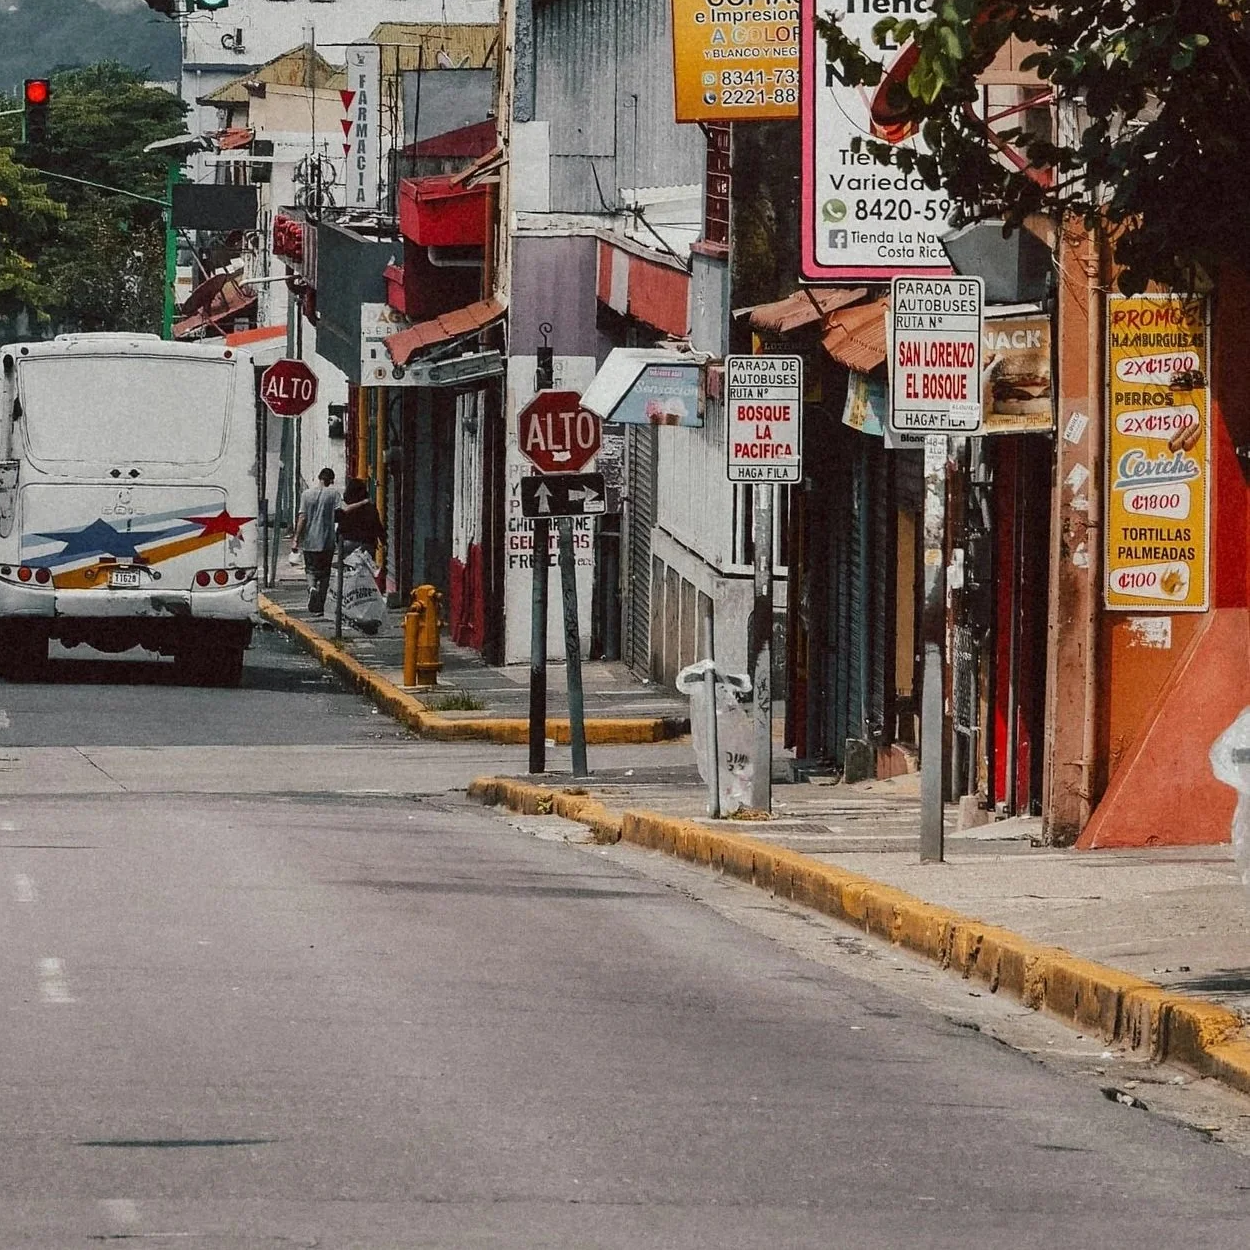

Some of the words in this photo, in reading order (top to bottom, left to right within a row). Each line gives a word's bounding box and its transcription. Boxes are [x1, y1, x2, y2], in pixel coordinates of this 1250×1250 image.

[695, 11, 705, 23] e
[712, 28, 726, 43] A
[713, 47, 760, 58] BLANCO
[764, 47, 769, 57] Y
[355, 74, 368, 203] FARMACIA
[850, 231, 894, 244] Tienda
[898, 231, 913, 244] La
[877, 245, 915, 258] Costa
[919, 246, 948, 258] Rica
[898, 282, 952, 296] PARADA
[958, 283, 976, 296] DE
[898, 299, 977, 312] AUTOBUSES
[896, 315, 924, 328] RUTA
[983, 329, 1041, 350] NACK
[1111, 332, 1204, 348] HAMBURGUESAS
[898, 341, 920, 367] SAN
[924, 341, 975, 368] LORENZO
[731, 360, 776, 371] PARADA
[781, 360, 797, 371] DE
[731, 374, 797, 385] AUTOBUSES
[905, 373, 919, 399] EL
[922, 373, 967, 400] BOSQUE
[266, 375, 312, 401] ALTO
[730, 387, 754, 399] RUTA
[1114, 392, 1175, 406] PERROS
[737, 405, 791, 421] BOSQUE
[905, 413, 935, 426] HAGA
[526, 410, 595, 452] ALTO
[755, 424, 772, 440] LA
[734, 443, 792, 459] PACIFICA
[1119, 450, 1199, 479] Ceviche
[738, 467, 763, 479] HAGA
[767, 467, 789, 479] FILA
[1121, 527, 1191, 541] TORTILLAS
[1117, 546, 1196, 561] PALMEADAS
[115, 571, 137, 583] 11628
